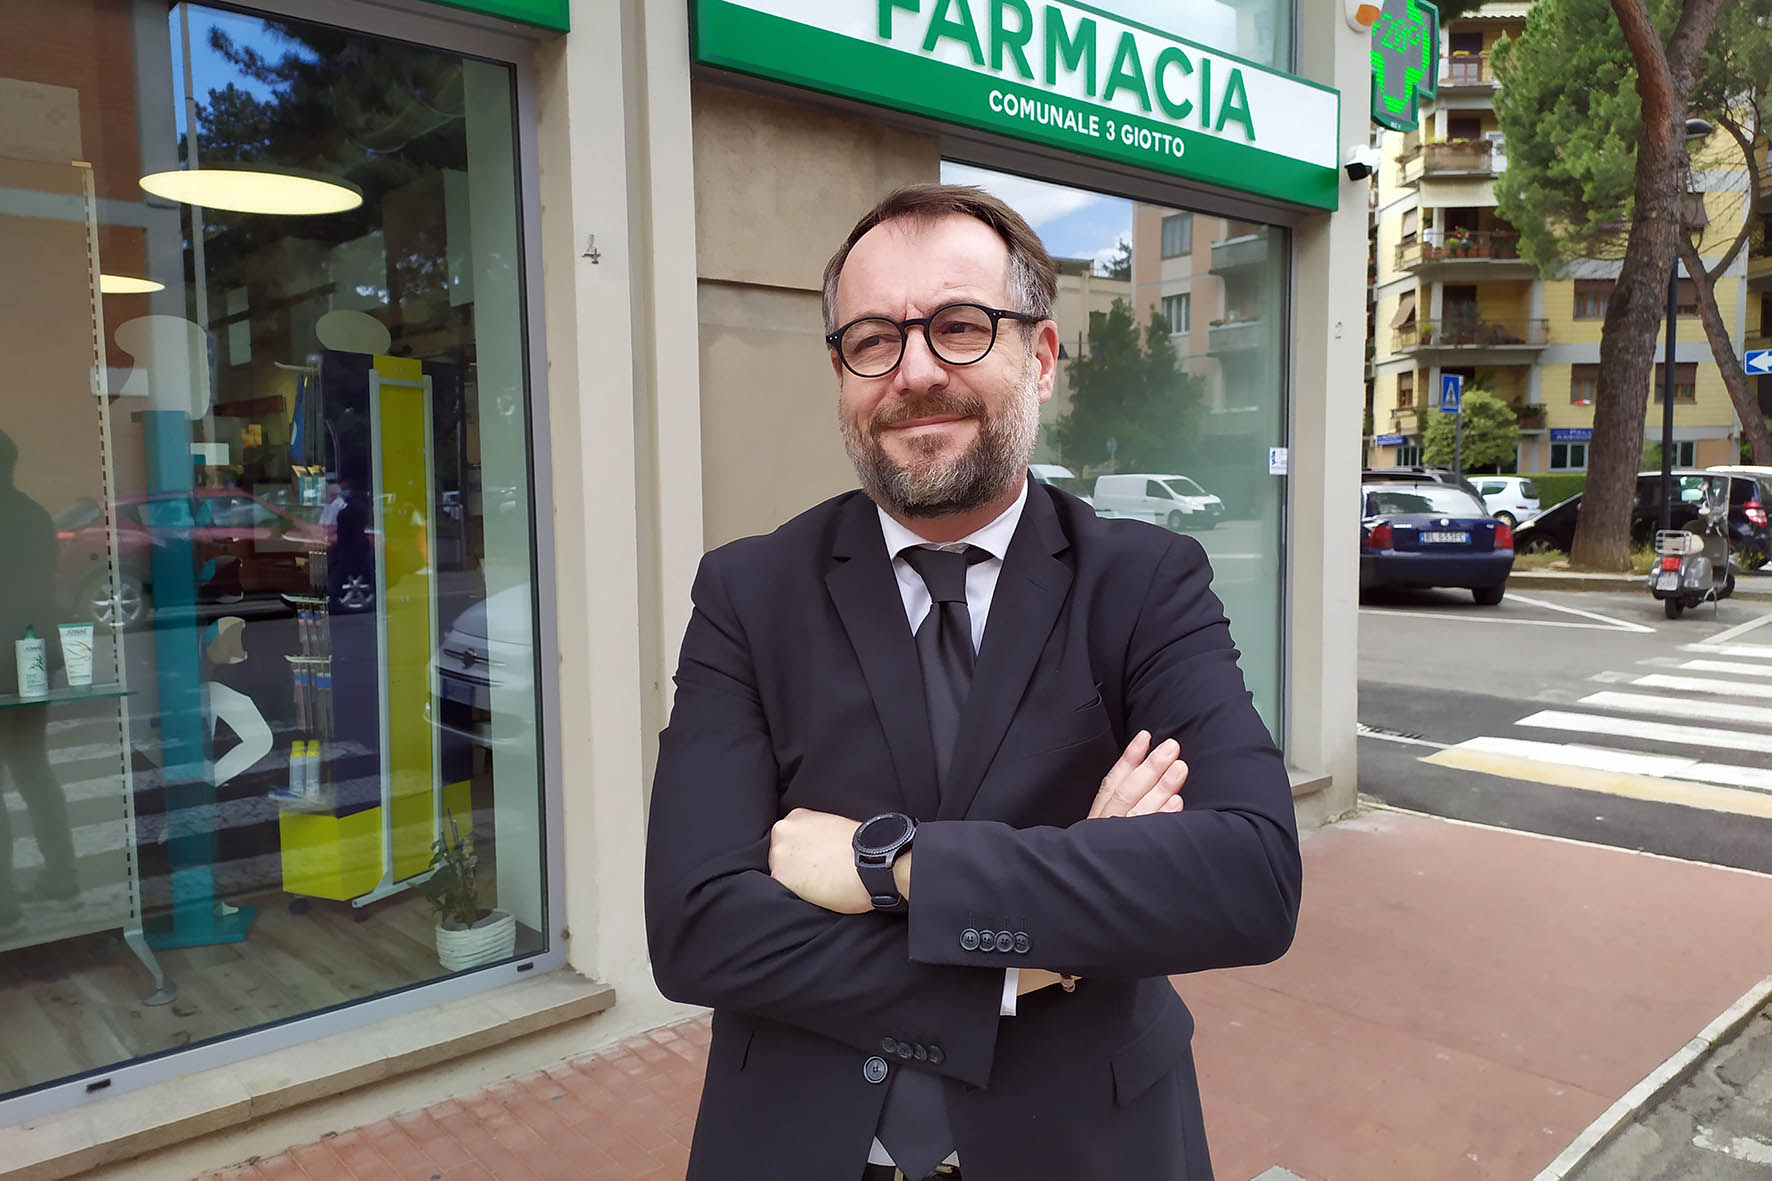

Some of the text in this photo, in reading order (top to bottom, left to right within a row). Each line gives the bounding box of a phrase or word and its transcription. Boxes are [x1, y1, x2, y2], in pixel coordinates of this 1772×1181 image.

[988, 90, 1185, 158] COMUNALE 3 GIOTTO
[581, 233, 601, 265] 4
